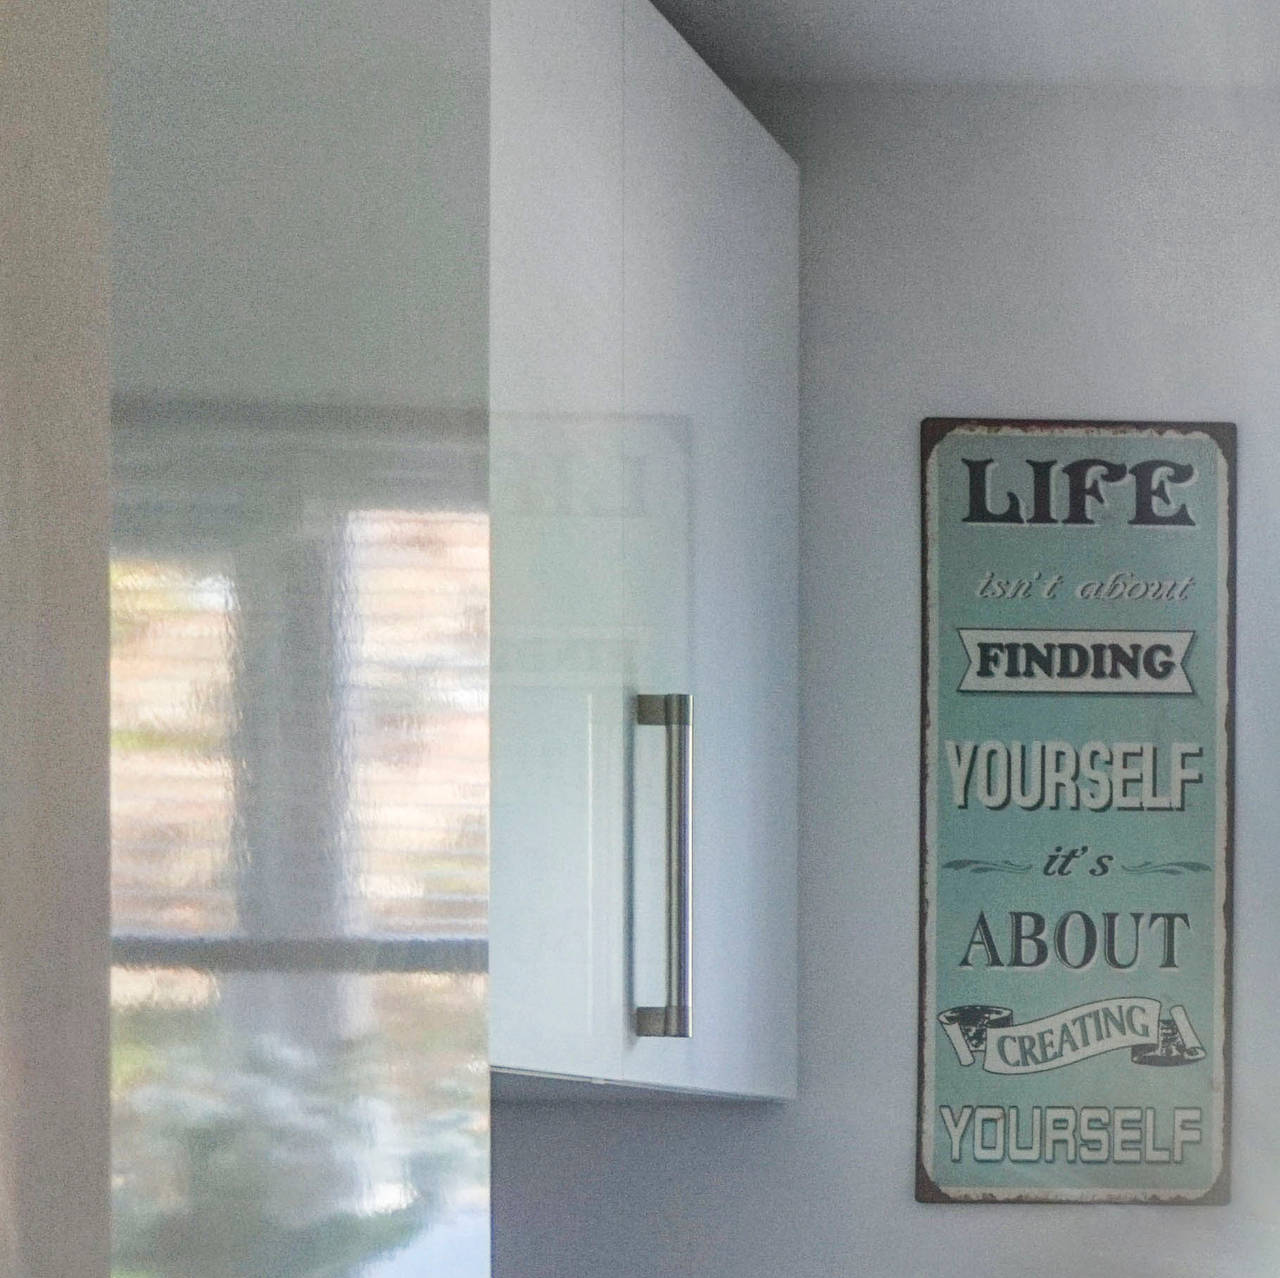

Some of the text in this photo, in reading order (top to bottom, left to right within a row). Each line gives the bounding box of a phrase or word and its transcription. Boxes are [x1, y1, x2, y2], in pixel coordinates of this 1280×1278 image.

[962, 458, 1196, 526] LIFE
[976, 567, 1196, 600] isn't about
[976, 642, 1176, 679] FINDING
[944, 740, 1204, 812] YOURSELF
[1042, 845, 1114, 876] it's
[959, 910, 1191, 969] ABOUT
[996, 1004, 1150, 1067] CREATING
[939, 1105, 1202, 1163] YOURSELF
